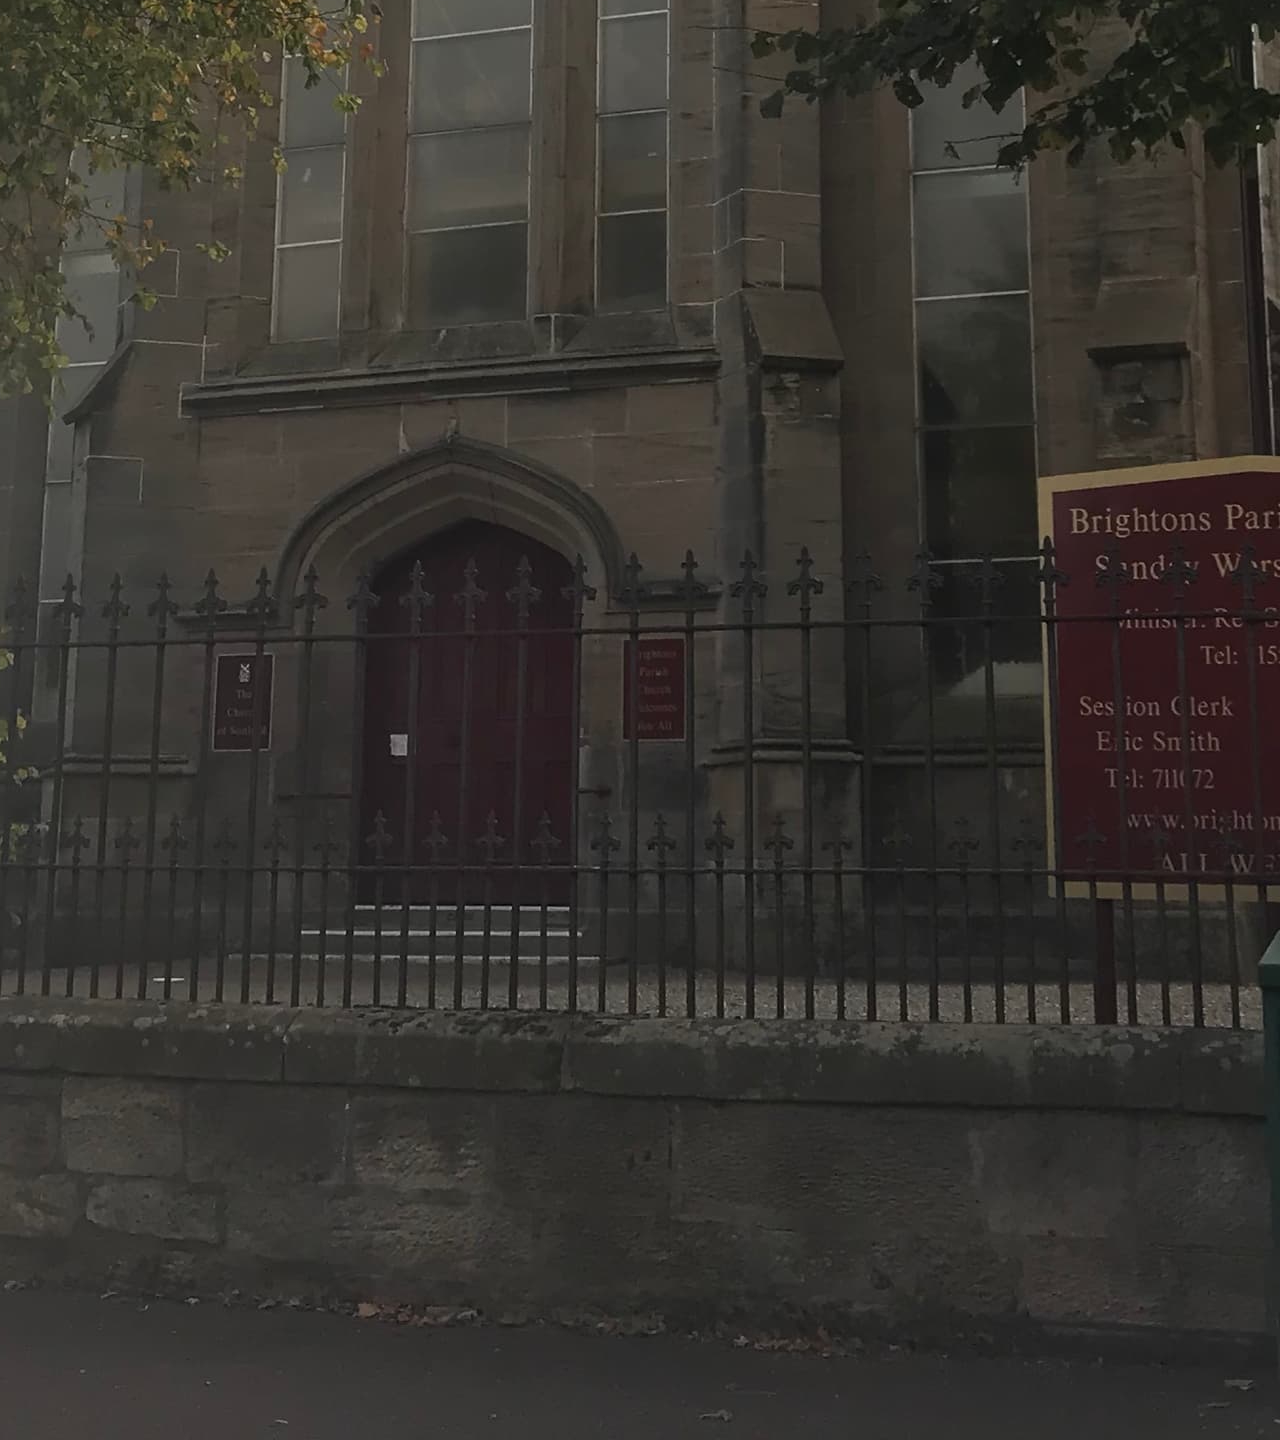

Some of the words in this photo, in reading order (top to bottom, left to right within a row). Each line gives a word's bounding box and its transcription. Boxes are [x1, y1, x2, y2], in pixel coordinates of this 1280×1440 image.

[1069, 506, 1212, 539] Brightons
[1200, 645, 1239, 665] Tel:
[1079, 695, 1161, 717] Sesion
